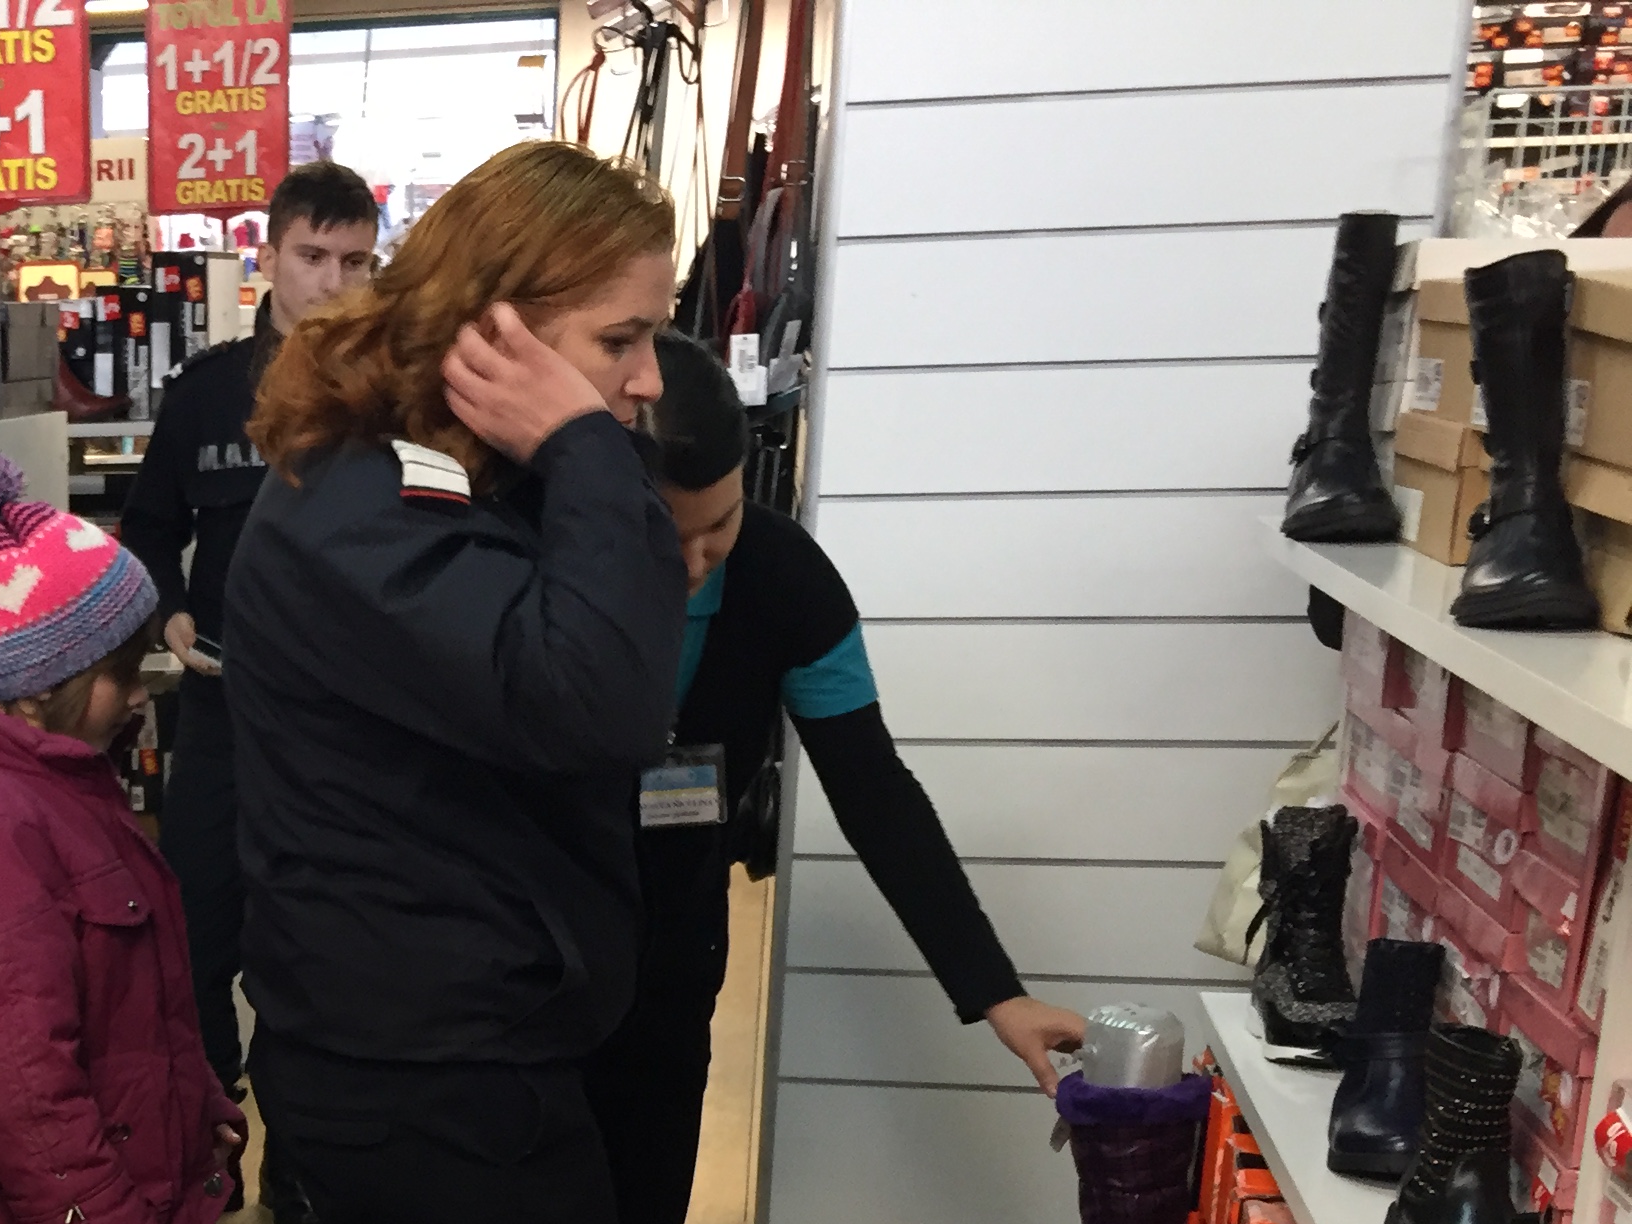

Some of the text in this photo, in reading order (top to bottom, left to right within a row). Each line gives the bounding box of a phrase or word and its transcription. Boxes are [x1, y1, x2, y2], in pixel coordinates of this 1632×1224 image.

[156, 38, 281, 91] 1+1/2
[175, 86, 267, 115] GRATIS
[177, 130, 258, 180] 2+1
[96, 158, 135, 182] RII
[175, 178, 266, 205] GRATIS
